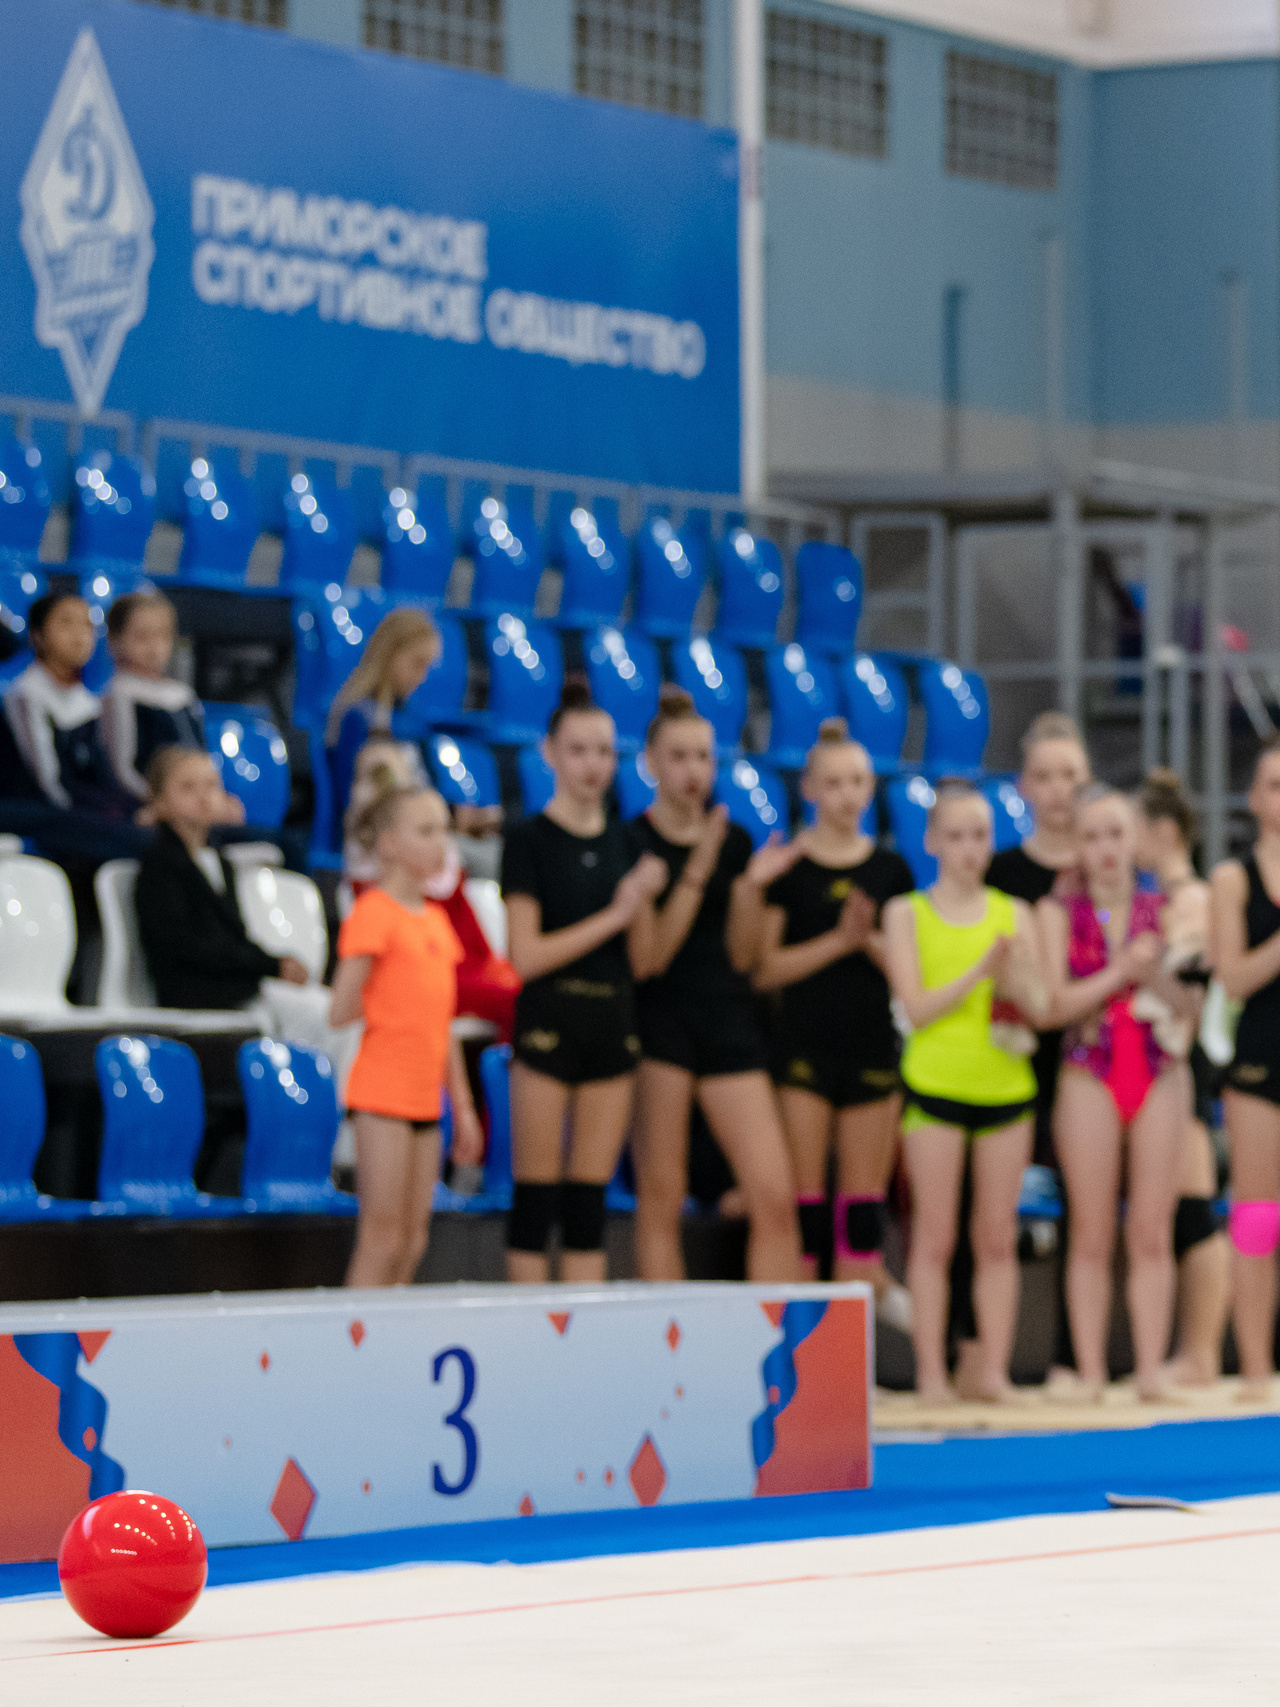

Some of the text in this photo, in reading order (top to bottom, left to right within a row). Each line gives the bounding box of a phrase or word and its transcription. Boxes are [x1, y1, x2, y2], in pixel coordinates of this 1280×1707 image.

[192, 173, 488, 281] ПРИМОРСКОЕ
[192, 241, 484, 344] СПОРТИВНОЕ
[485, 288, 706, 378] ОБЩЕСТВО
[431, 1346, 479, 1496] 3
